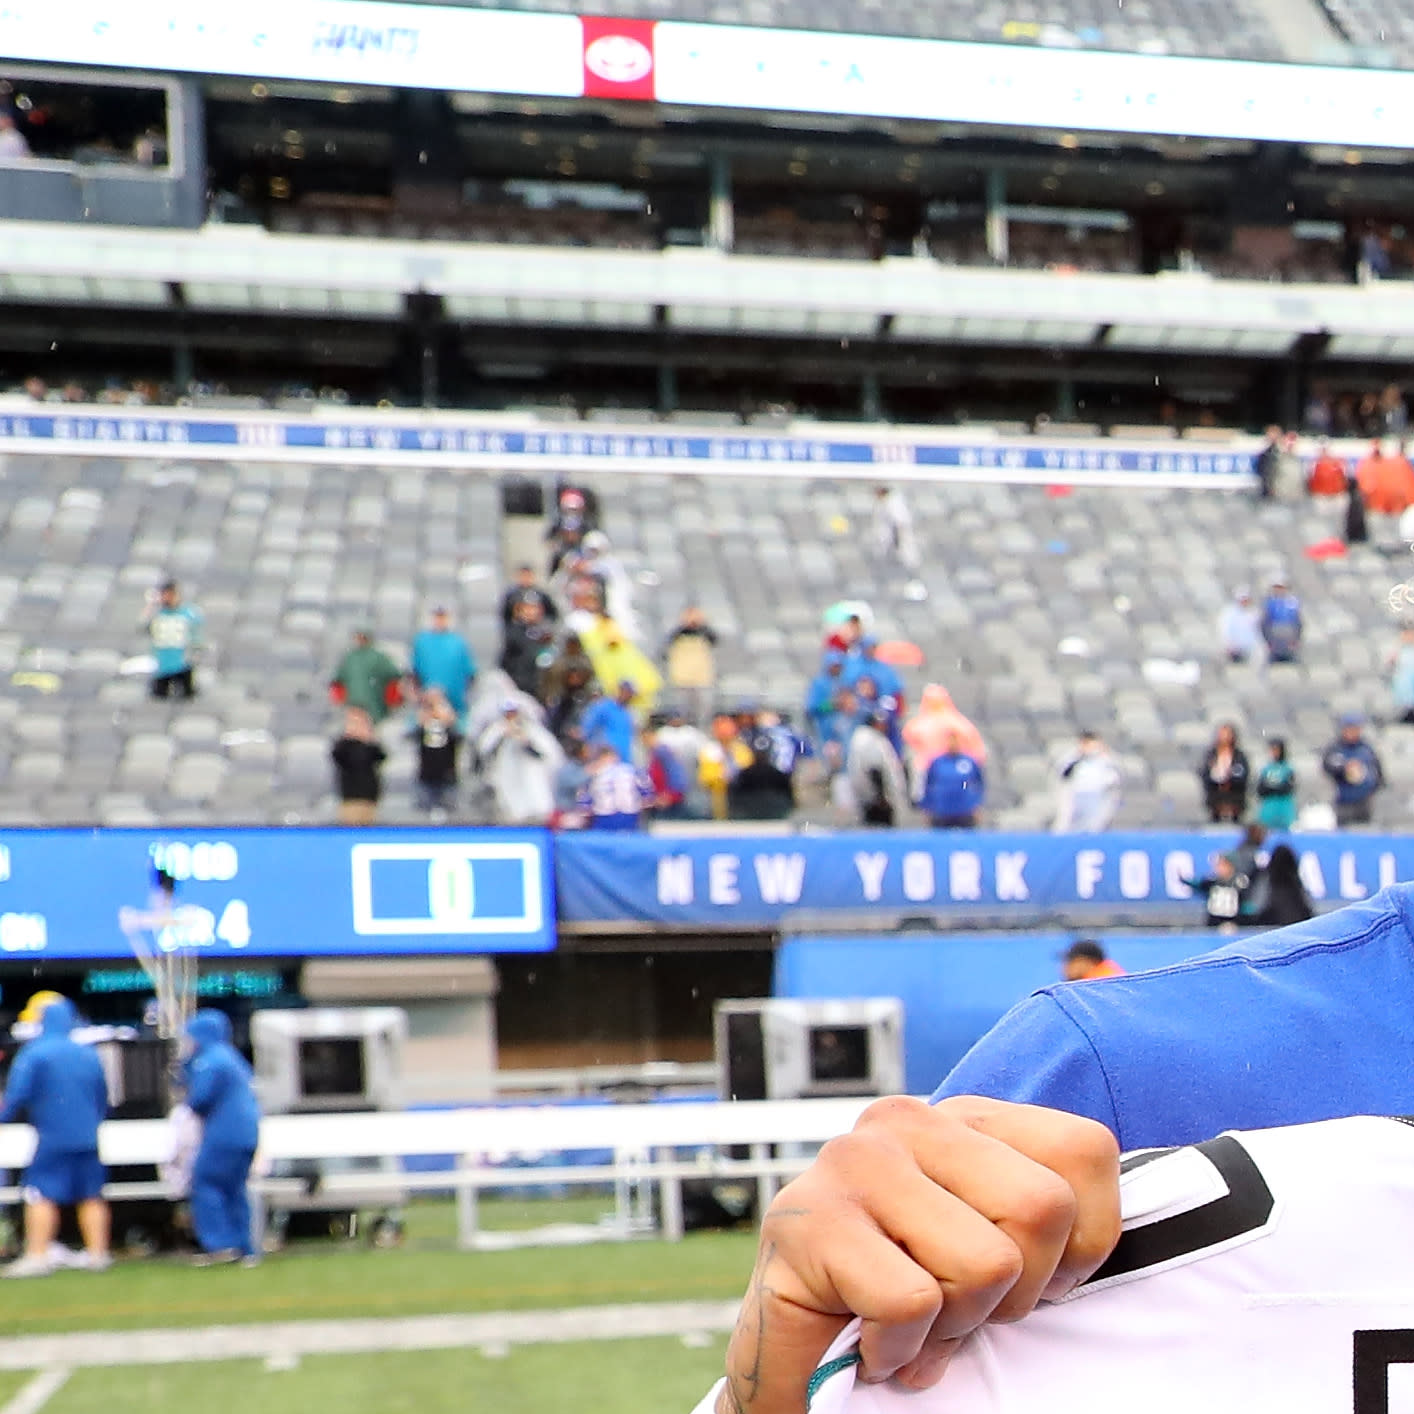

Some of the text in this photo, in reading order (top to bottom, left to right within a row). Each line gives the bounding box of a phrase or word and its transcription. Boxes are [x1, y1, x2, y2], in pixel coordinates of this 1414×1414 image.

[656, 849, 1397, 905] NEW YORK FOOALL
